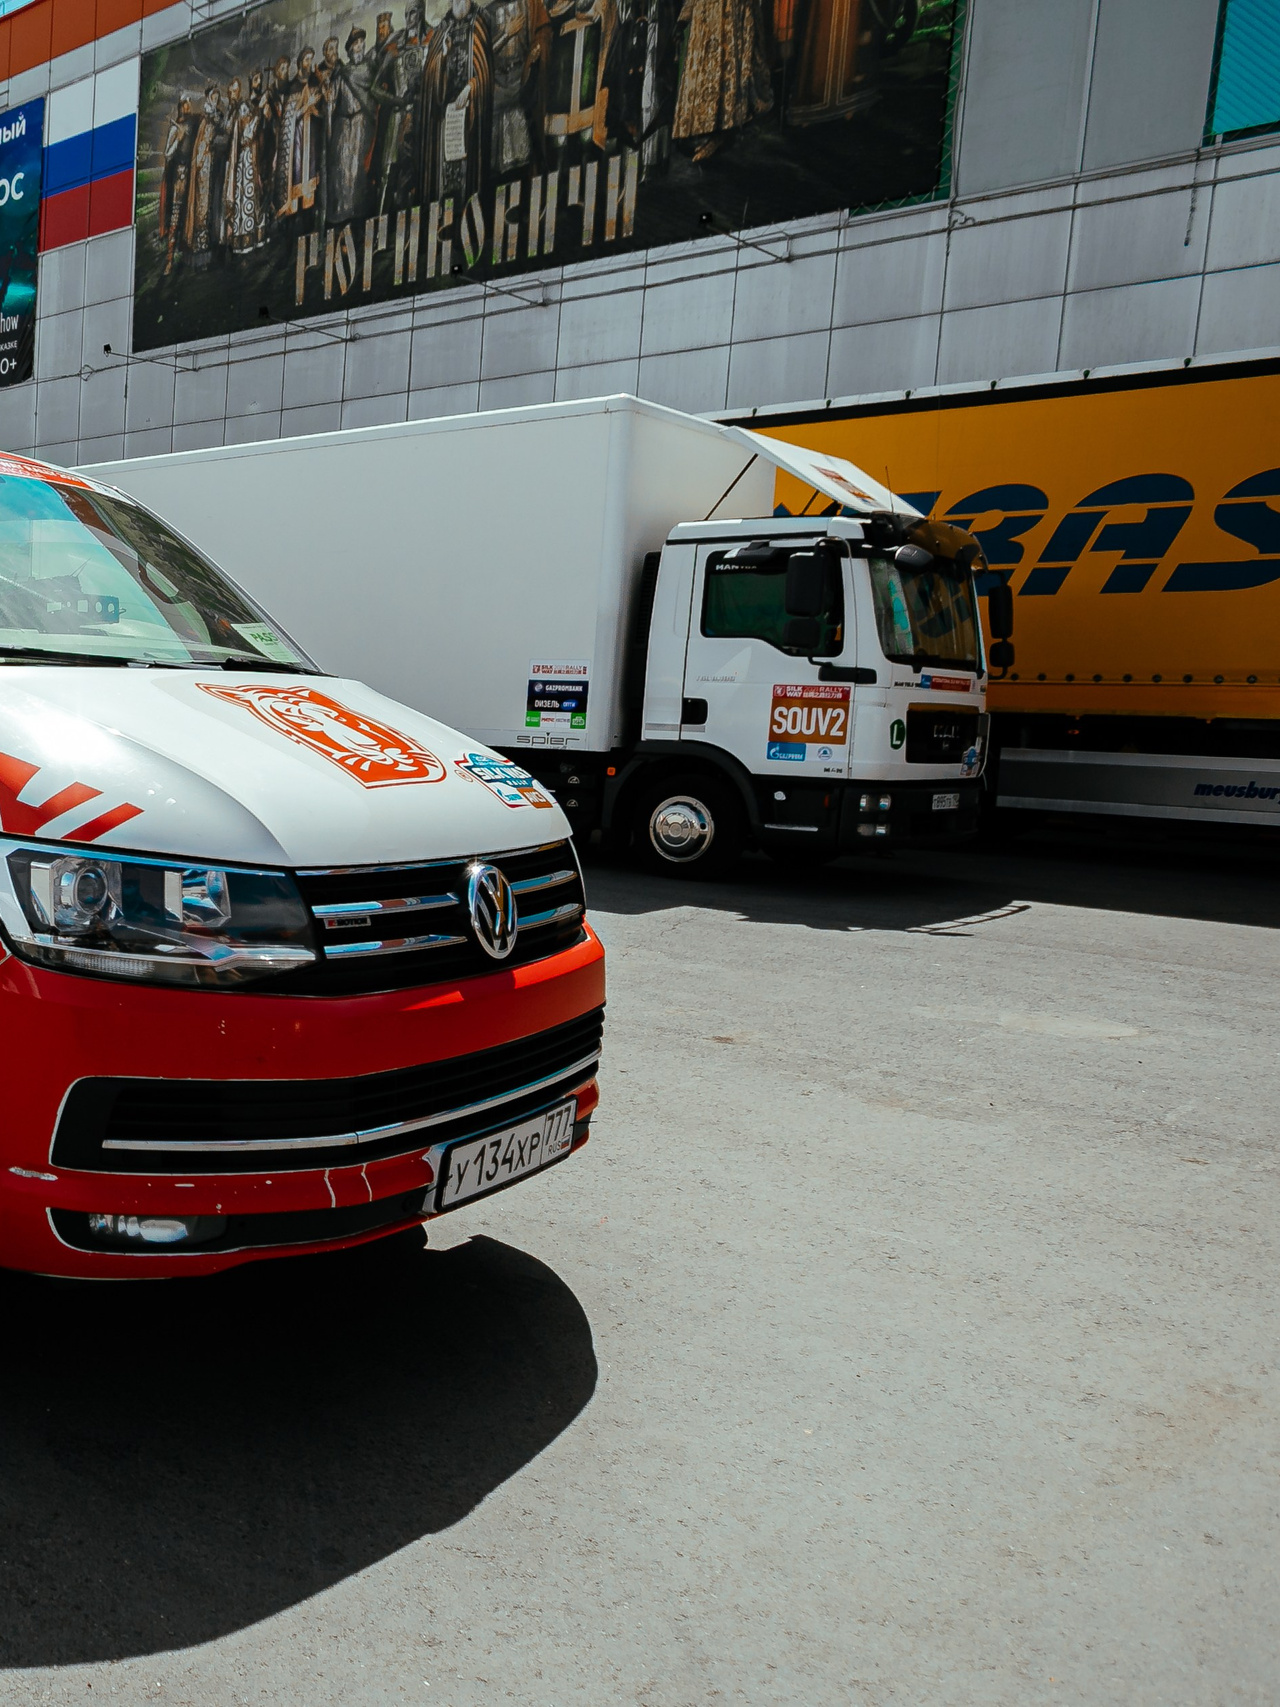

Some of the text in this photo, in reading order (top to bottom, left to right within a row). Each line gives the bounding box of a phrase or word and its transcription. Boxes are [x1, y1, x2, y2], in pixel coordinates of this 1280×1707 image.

[0, 358, 18, 374] 0+
[250, 632, 279, 642] PASS
[545, 684, 583, 692] GAZPROMBANK
[772, 706, 846, 737] SOUV2
[516, 732, 580, 747] spier
[1194, 781, 1280, 804] meusbur
[544, 1105, 572, 1146] 777
[548, 1141, 562, 1156] RUS
